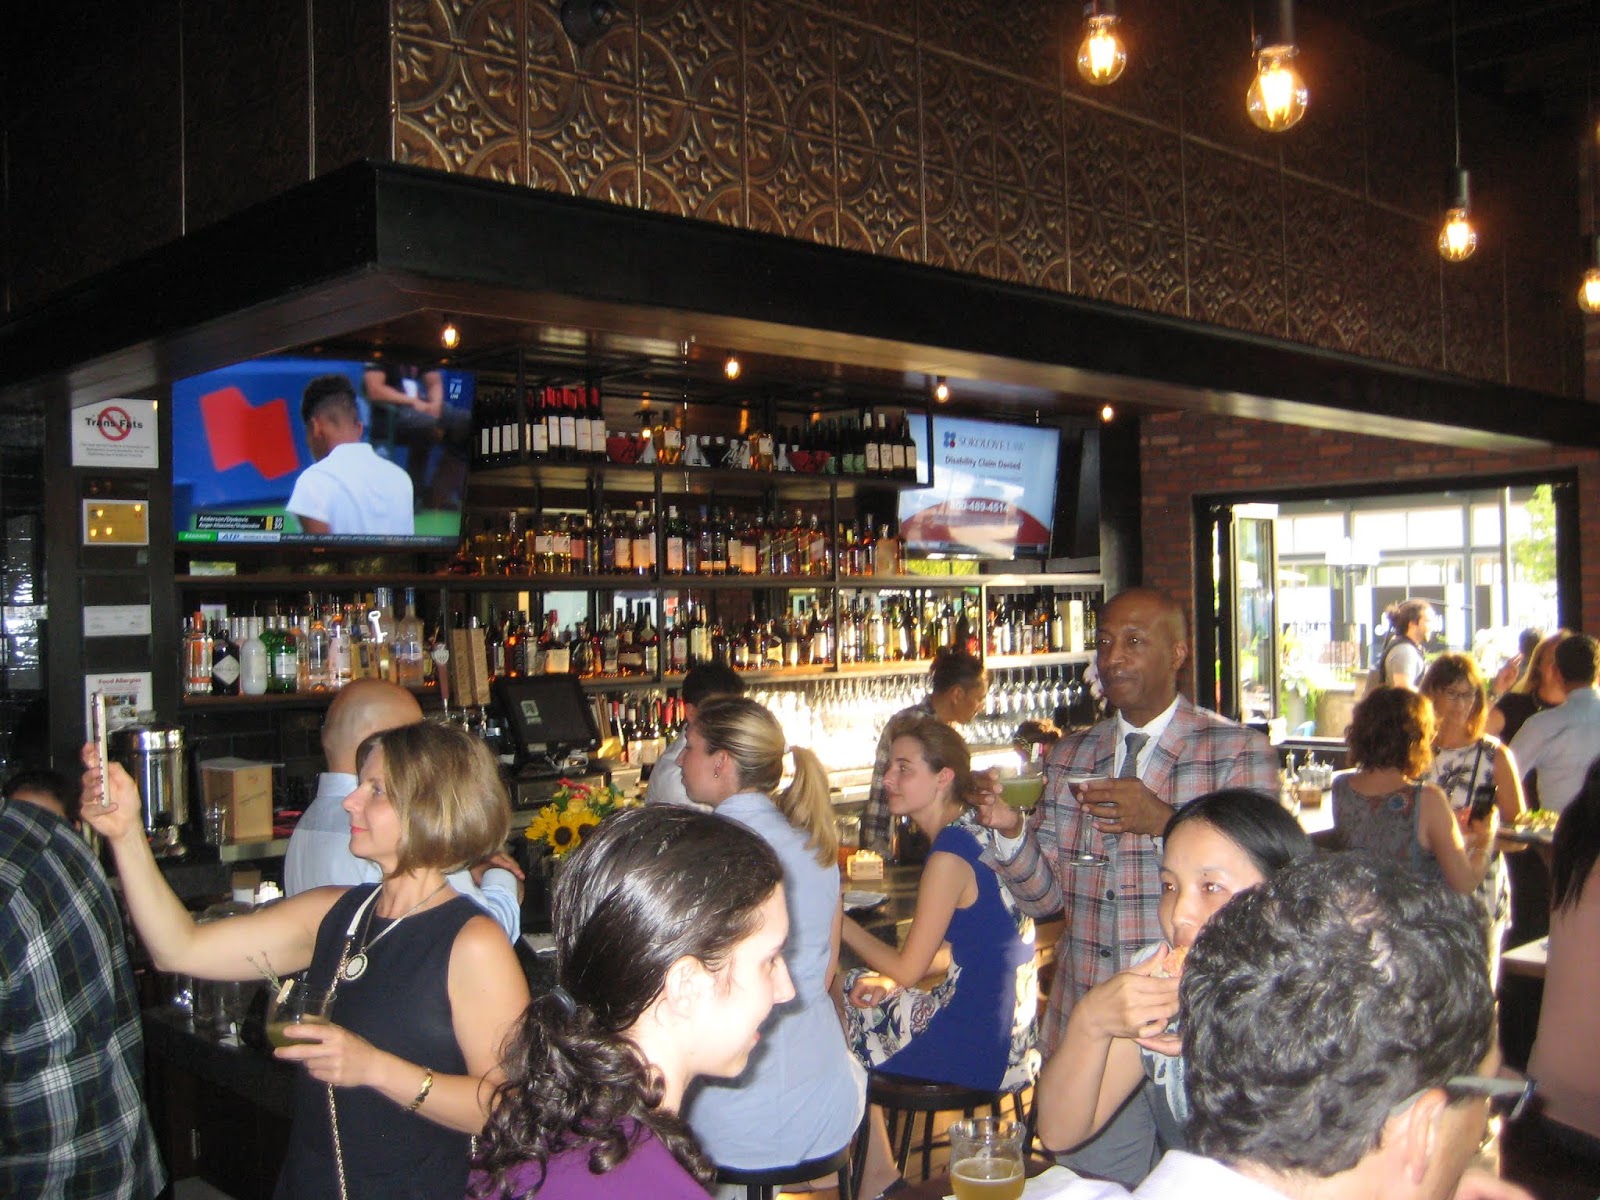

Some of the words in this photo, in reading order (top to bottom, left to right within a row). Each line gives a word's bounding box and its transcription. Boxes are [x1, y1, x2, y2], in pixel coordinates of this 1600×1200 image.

[85, 417, 116, 427] Trans
[119, 419, 144, 429] Fats
[945, 455, 976, 468] Disability
[978, 458, 997, 467] Claim
[998, 460, 1021, 470] Denied
